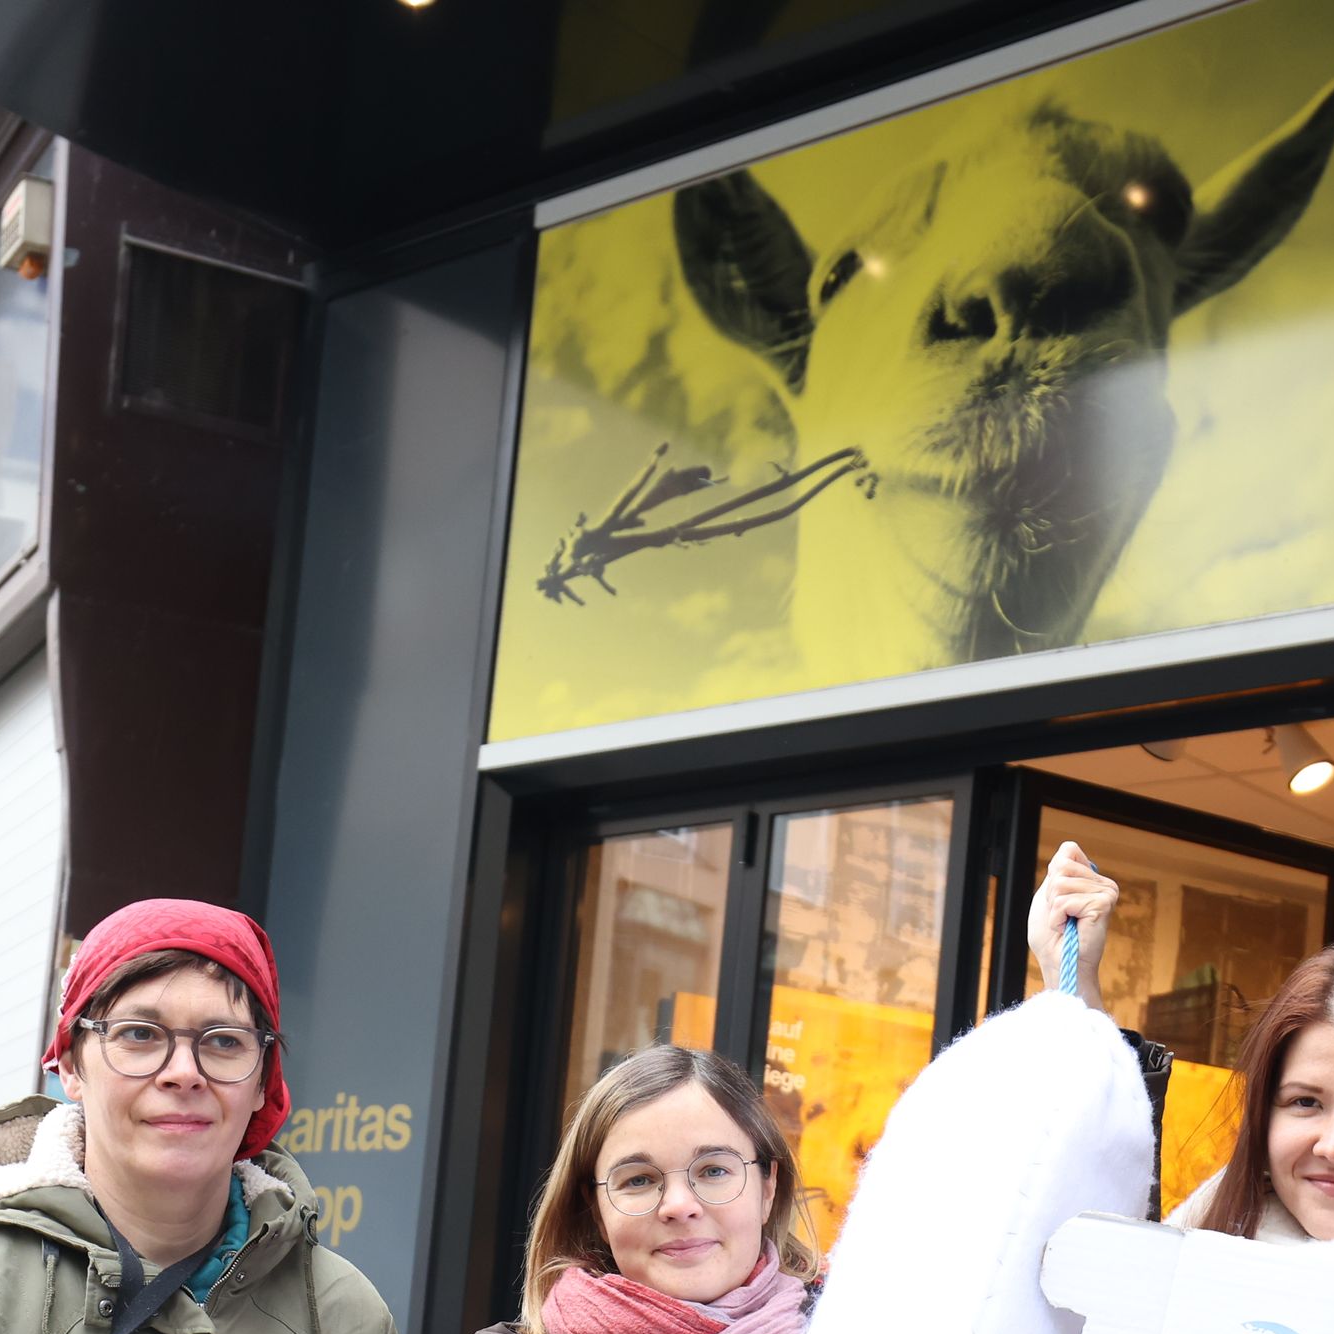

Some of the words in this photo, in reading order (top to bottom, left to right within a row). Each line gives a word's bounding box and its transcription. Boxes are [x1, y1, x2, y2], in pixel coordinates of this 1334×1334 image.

[769, 1020, 804, 1041] auf
[766, 1040, 796, 1064] ine
[764, 1063, 807, 1093] iege
[278, 1092, 412, 1152] aritas
[314, 1185, 363, 1247] op
